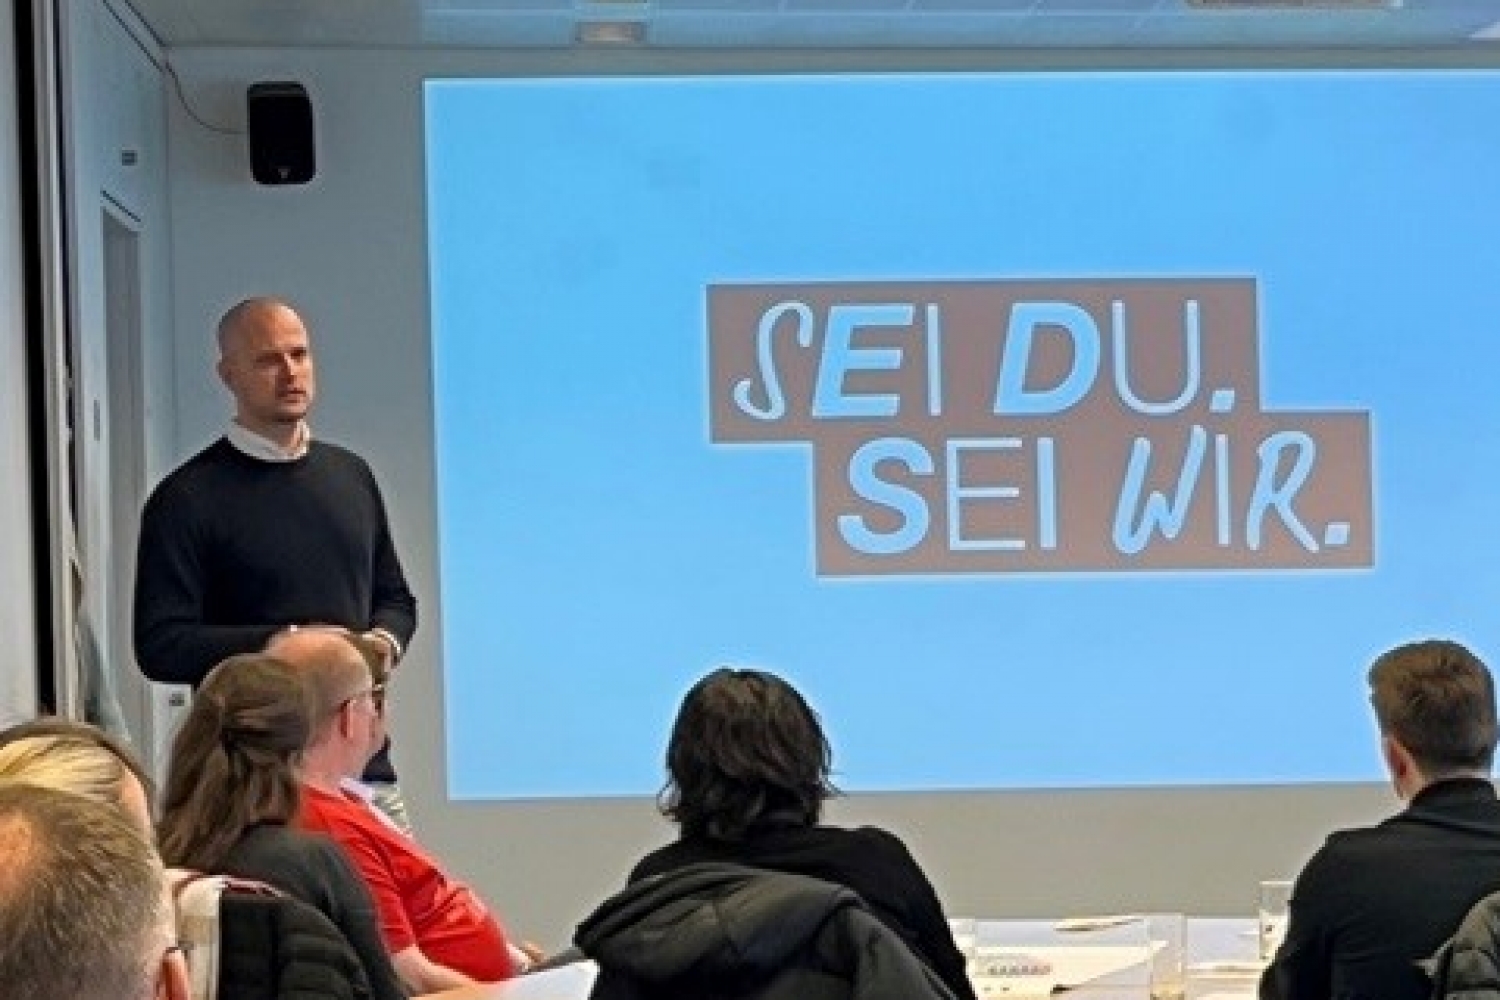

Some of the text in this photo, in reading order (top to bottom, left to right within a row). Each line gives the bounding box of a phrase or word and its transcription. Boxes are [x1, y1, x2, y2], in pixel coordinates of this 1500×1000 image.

[733, 300, 1236, 420] SEI DU.
[837, 424, 1351, 555] SEI WIR.
